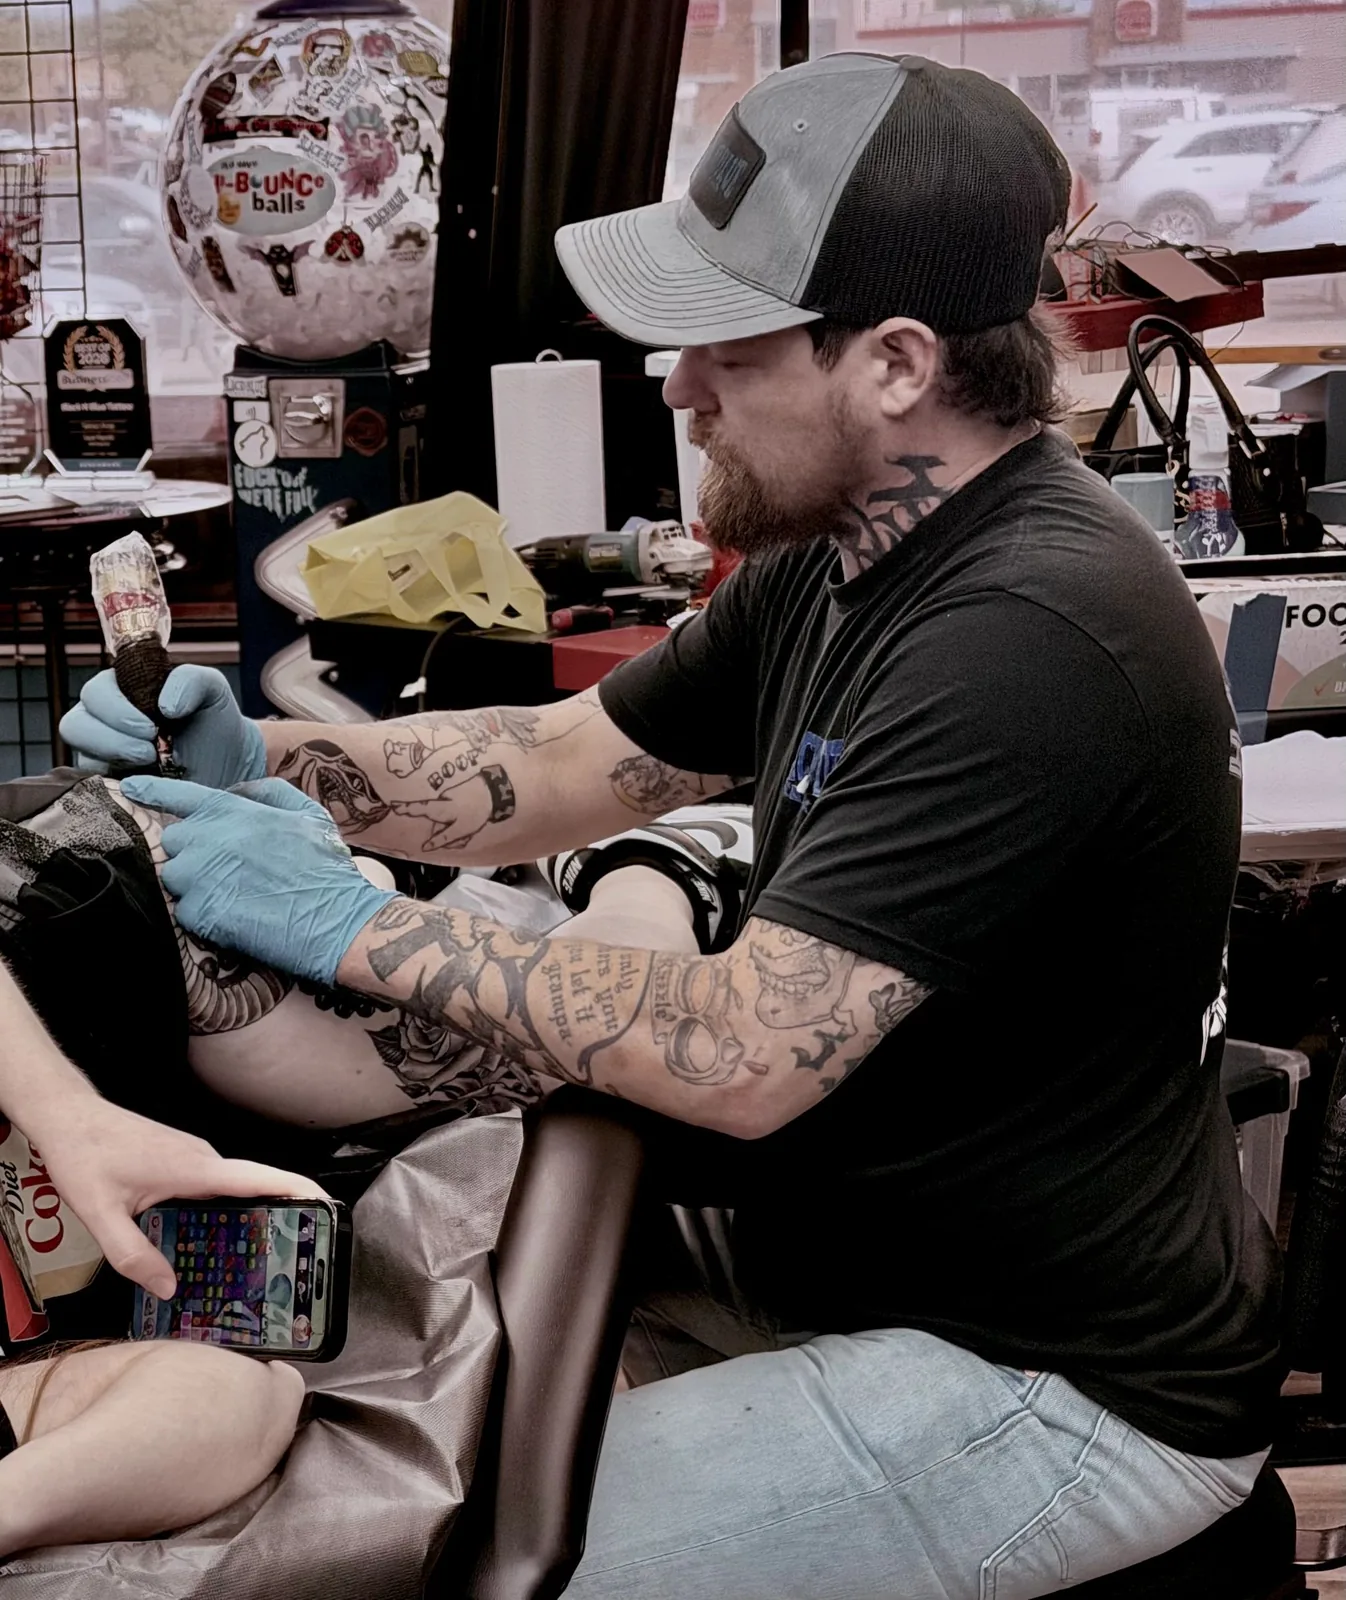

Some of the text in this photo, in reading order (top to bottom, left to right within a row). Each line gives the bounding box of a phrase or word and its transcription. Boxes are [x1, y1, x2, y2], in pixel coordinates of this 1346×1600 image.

[252, 191, 306, 214] balls
[234, 464, 277, 488] FUCK
[427, 748, 480, 791] BOOP
[562, 856, 583, 895] NIKE
[0, 1160, 24, 1215] Diet
